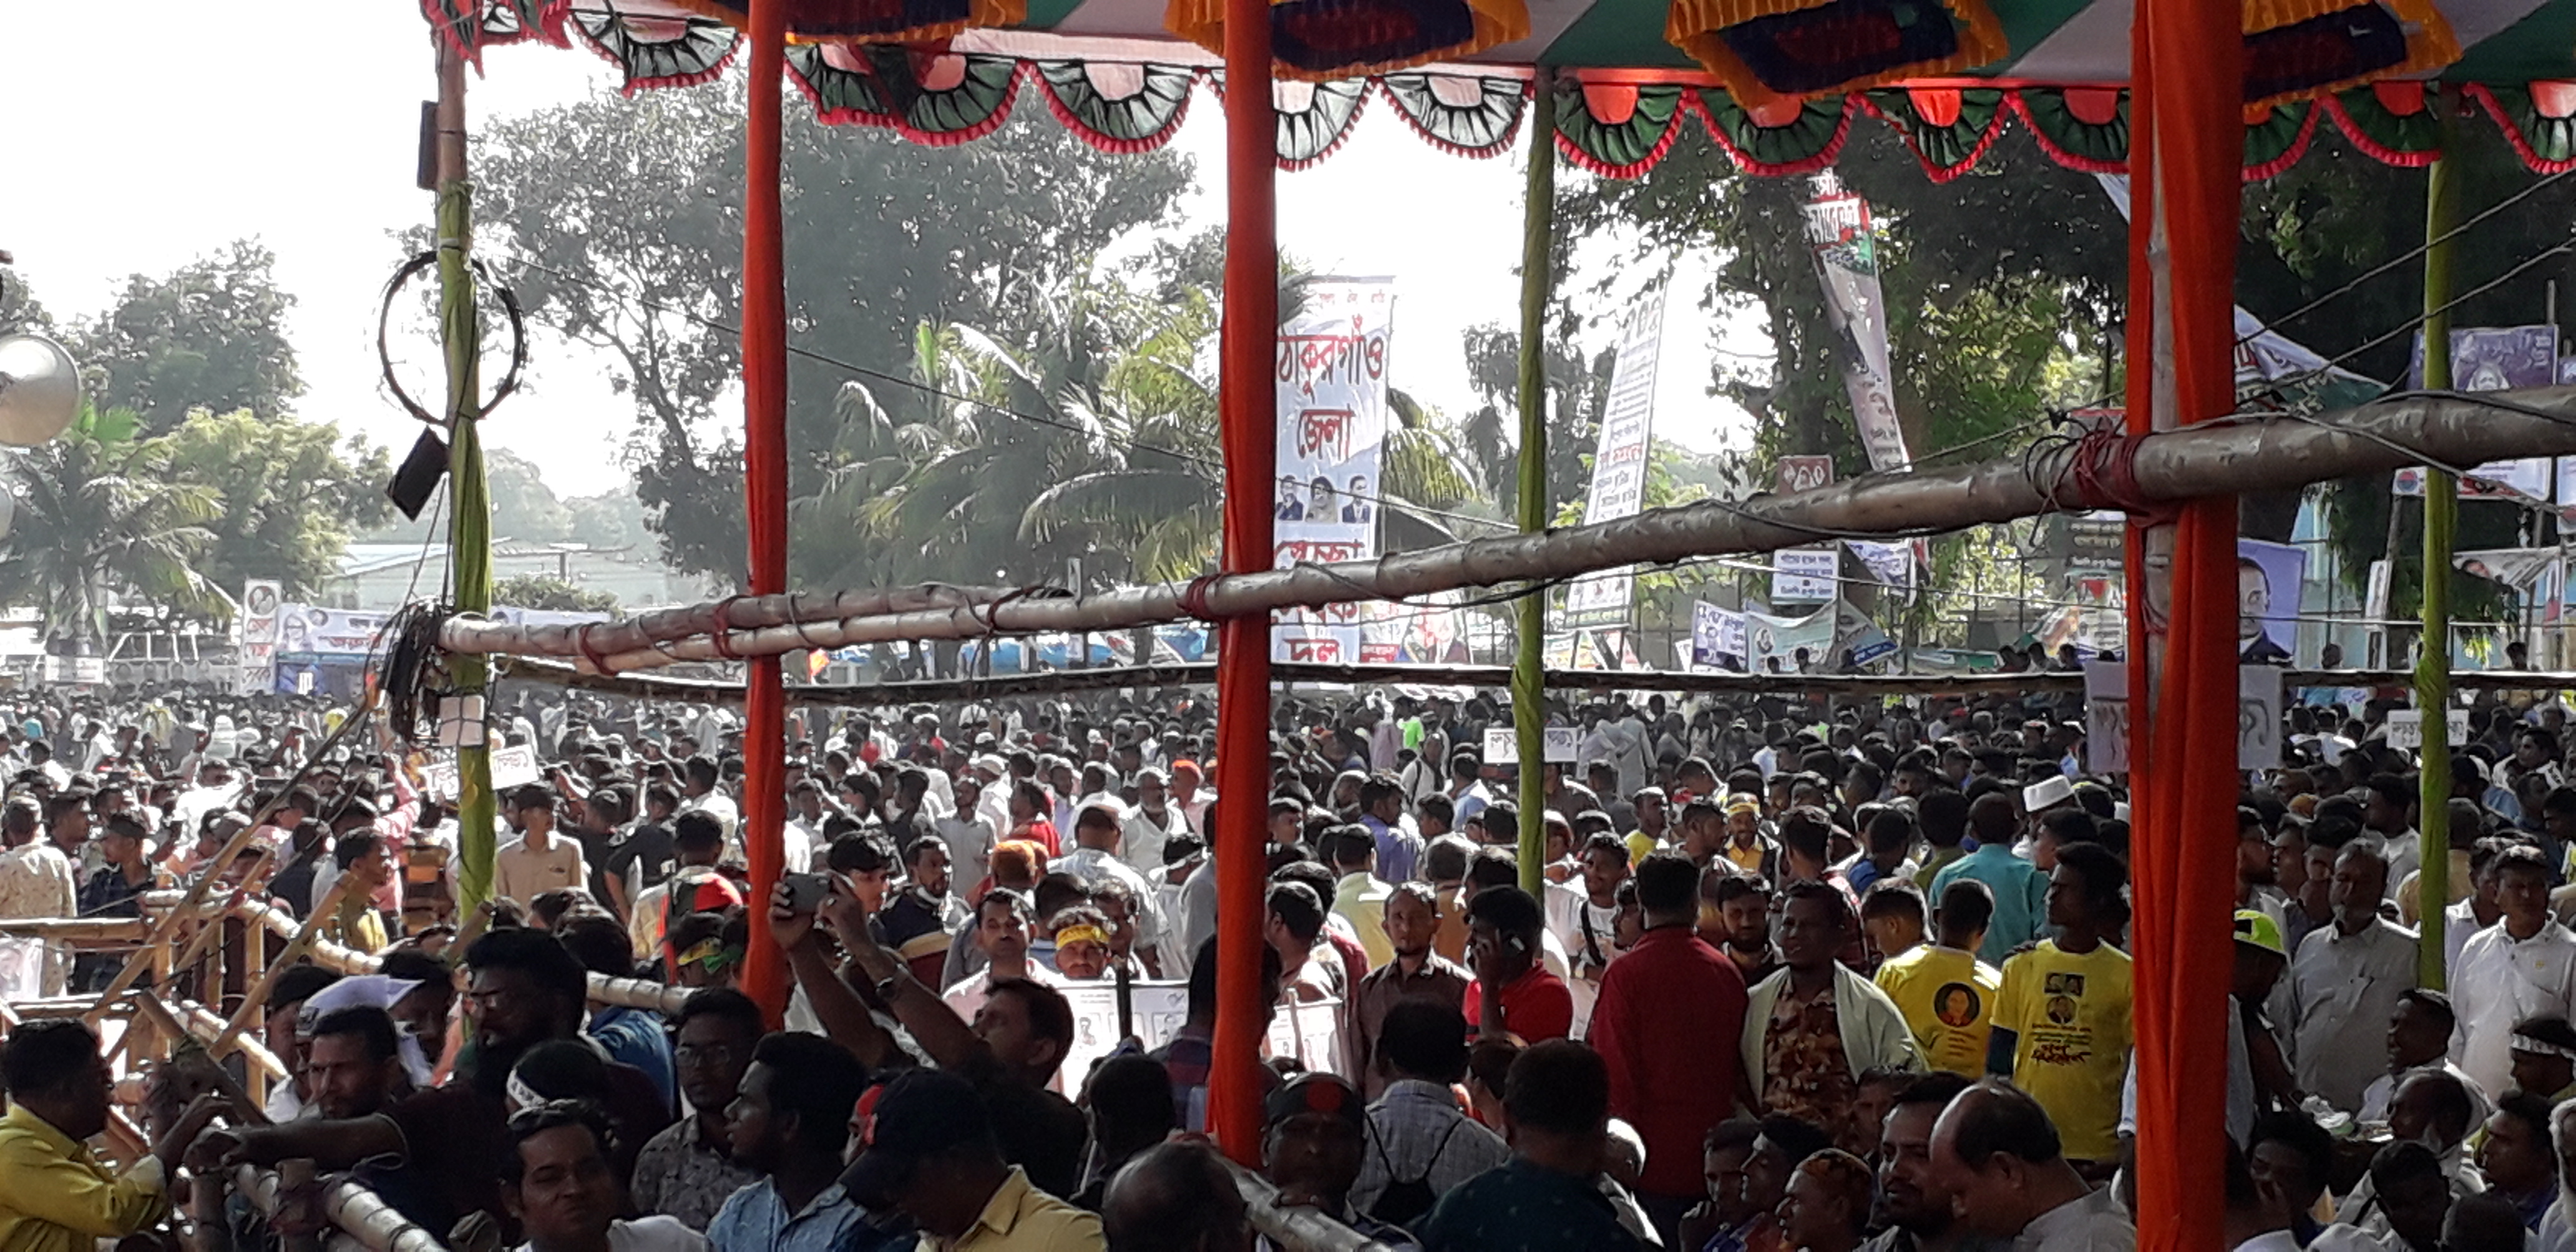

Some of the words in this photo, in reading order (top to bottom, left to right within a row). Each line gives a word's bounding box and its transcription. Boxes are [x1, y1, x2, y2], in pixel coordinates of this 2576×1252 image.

[1277, 314, 1384, 405] ঠাকুরগাঁও
[1297, 403, 1356, 463] জেলা
[1283, 638, 1340, 663] দল
